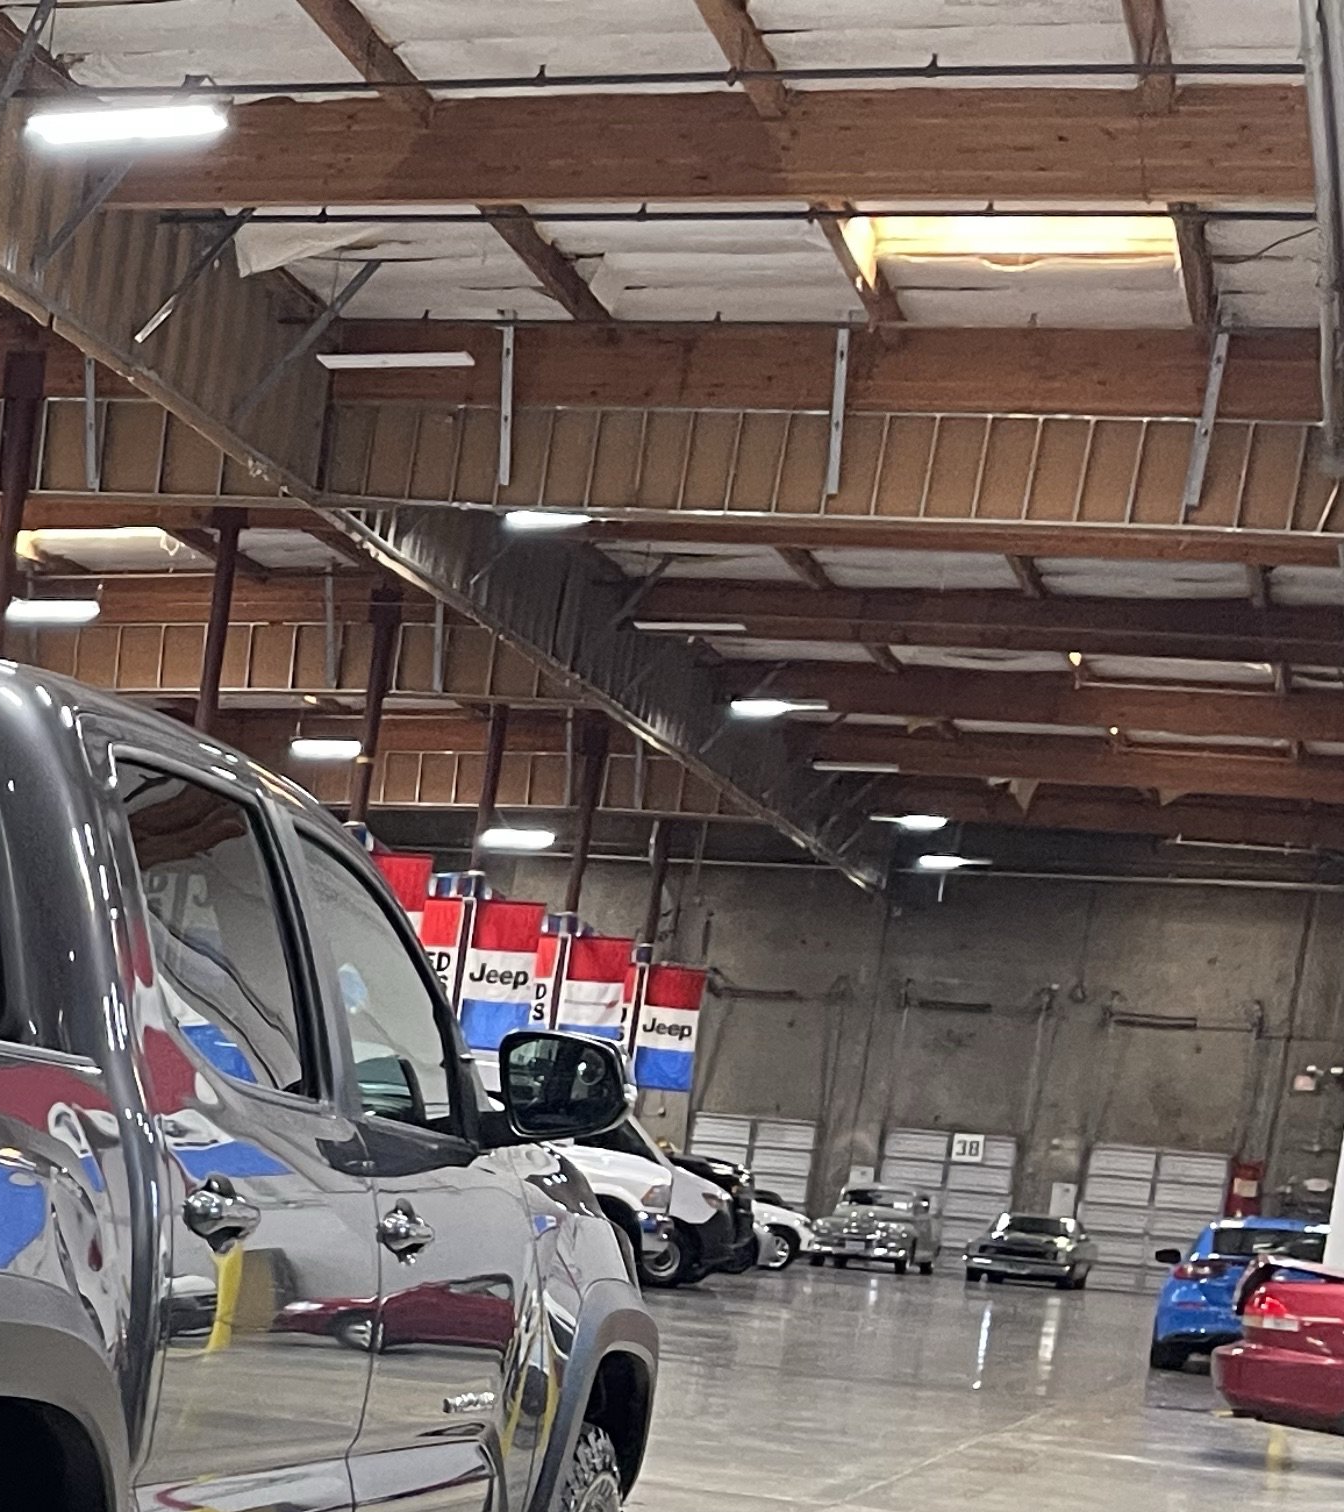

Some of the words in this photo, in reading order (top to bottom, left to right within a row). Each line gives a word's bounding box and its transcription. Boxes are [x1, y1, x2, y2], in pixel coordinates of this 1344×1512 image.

[469, 962, 529, 990] Jeep
[642, 1017, 693, 1041] Jeep
[955, 1139, 980, 1157] 38
